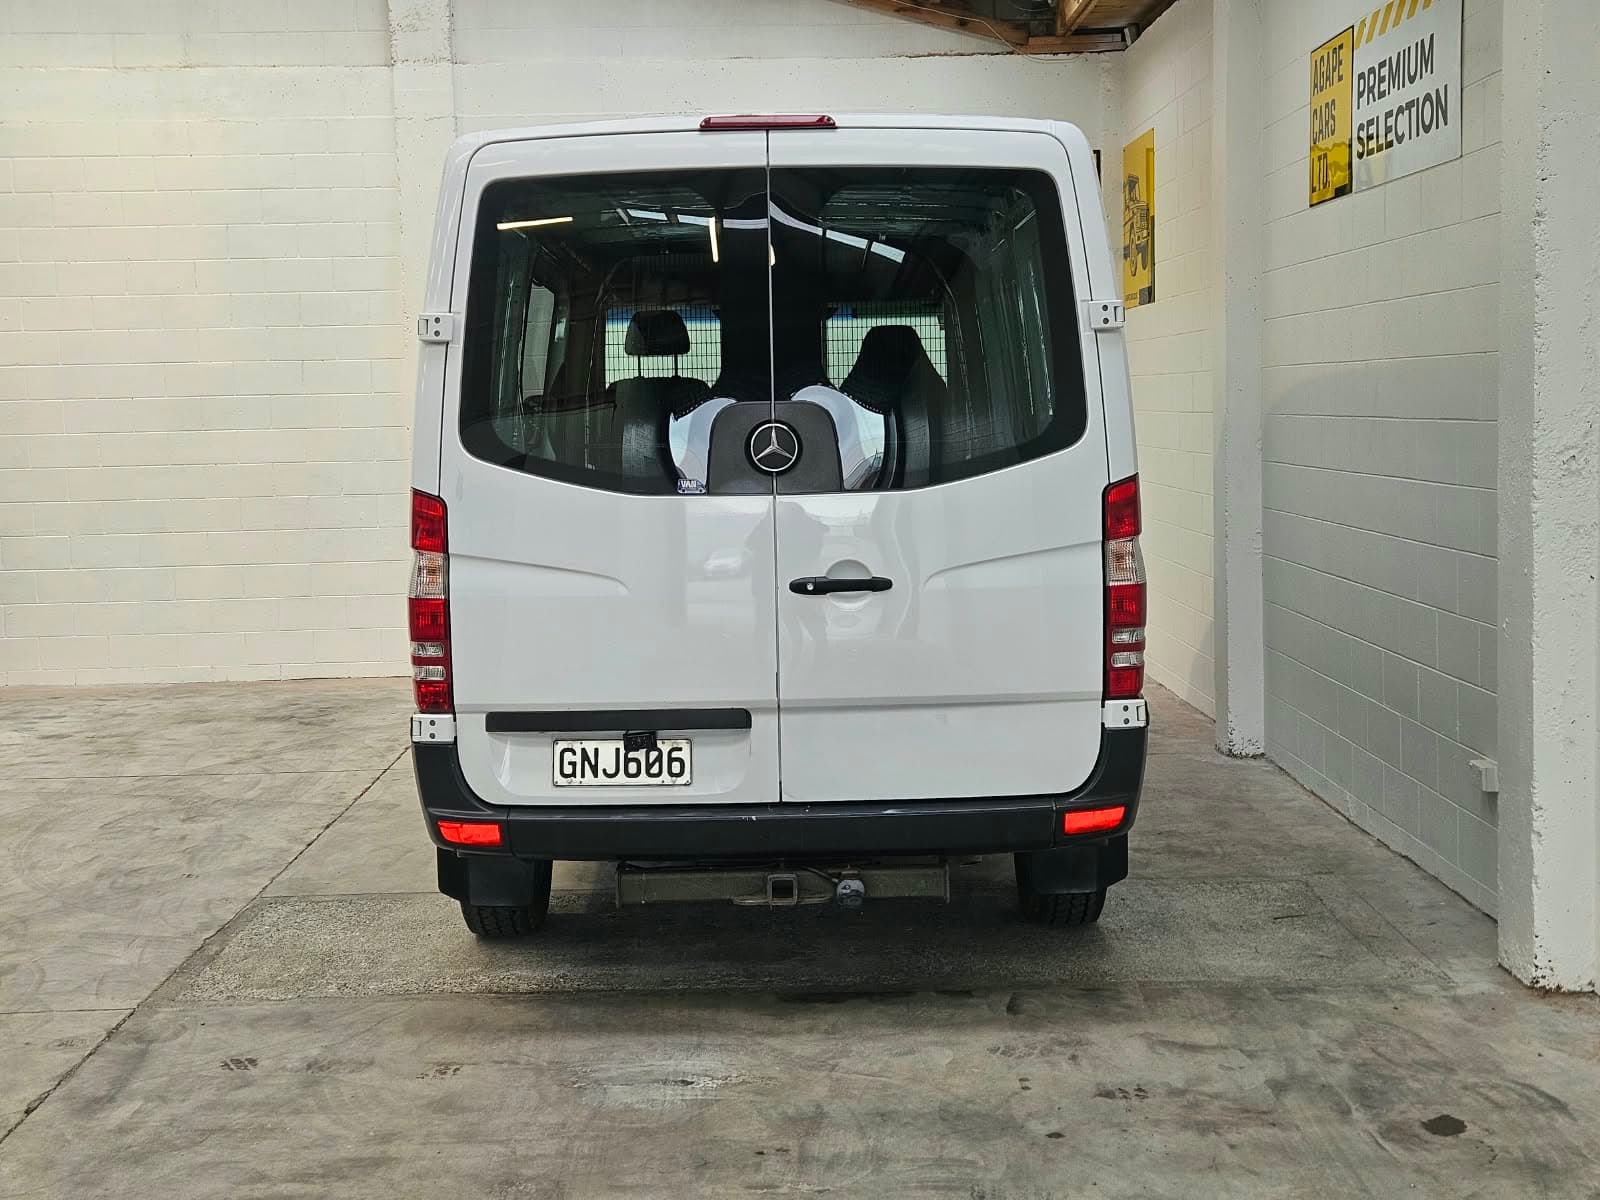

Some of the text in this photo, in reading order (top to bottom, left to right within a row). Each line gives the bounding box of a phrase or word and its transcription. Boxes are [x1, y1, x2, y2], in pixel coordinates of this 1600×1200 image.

[1312, 43, 1344, 97] AGAPE
[1356, 32, 1435, 110] PREMIUM
[1312, 98, 1336, 145] CARS
[1356, 83, 1448, 160] SELECTION
[559, 747, 686, 779] GNJ606
